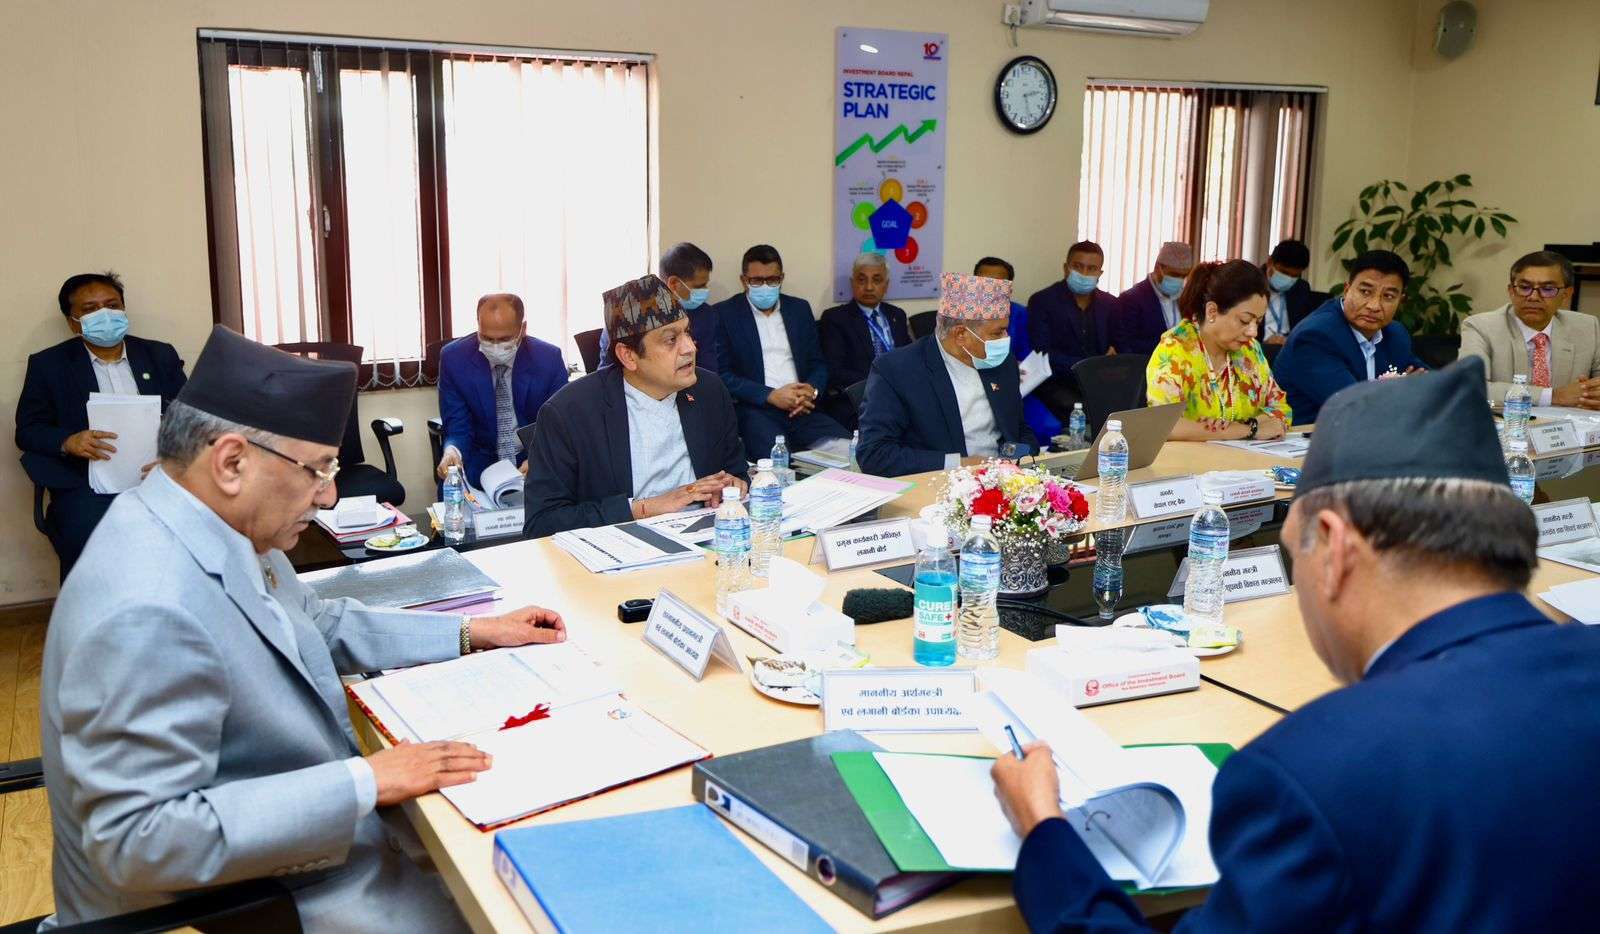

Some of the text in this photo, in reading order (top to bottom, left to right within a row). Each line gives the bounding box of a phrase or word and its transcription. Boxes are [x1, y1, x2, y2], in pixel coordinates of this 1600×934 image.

[843, 81, 936, 101] STRATEGIC
[843, 102, 889, 118] PLAN
[881, 220, 898, 229] GOAL
[856, 547, 876, 556] लगानी
[919, 600, 951, 612] CURE
[919, 613, 944, 621] SAFE
[1102, 681, 1119, 689] Office
[1119, 680, 1126, 688] of
[1138, 675, 1168, 685] Investment
[1168, 672, 1186, 680] Board
[858, 687, 897, 697] माननीय
[856, 706, 888, 716] लगानी
